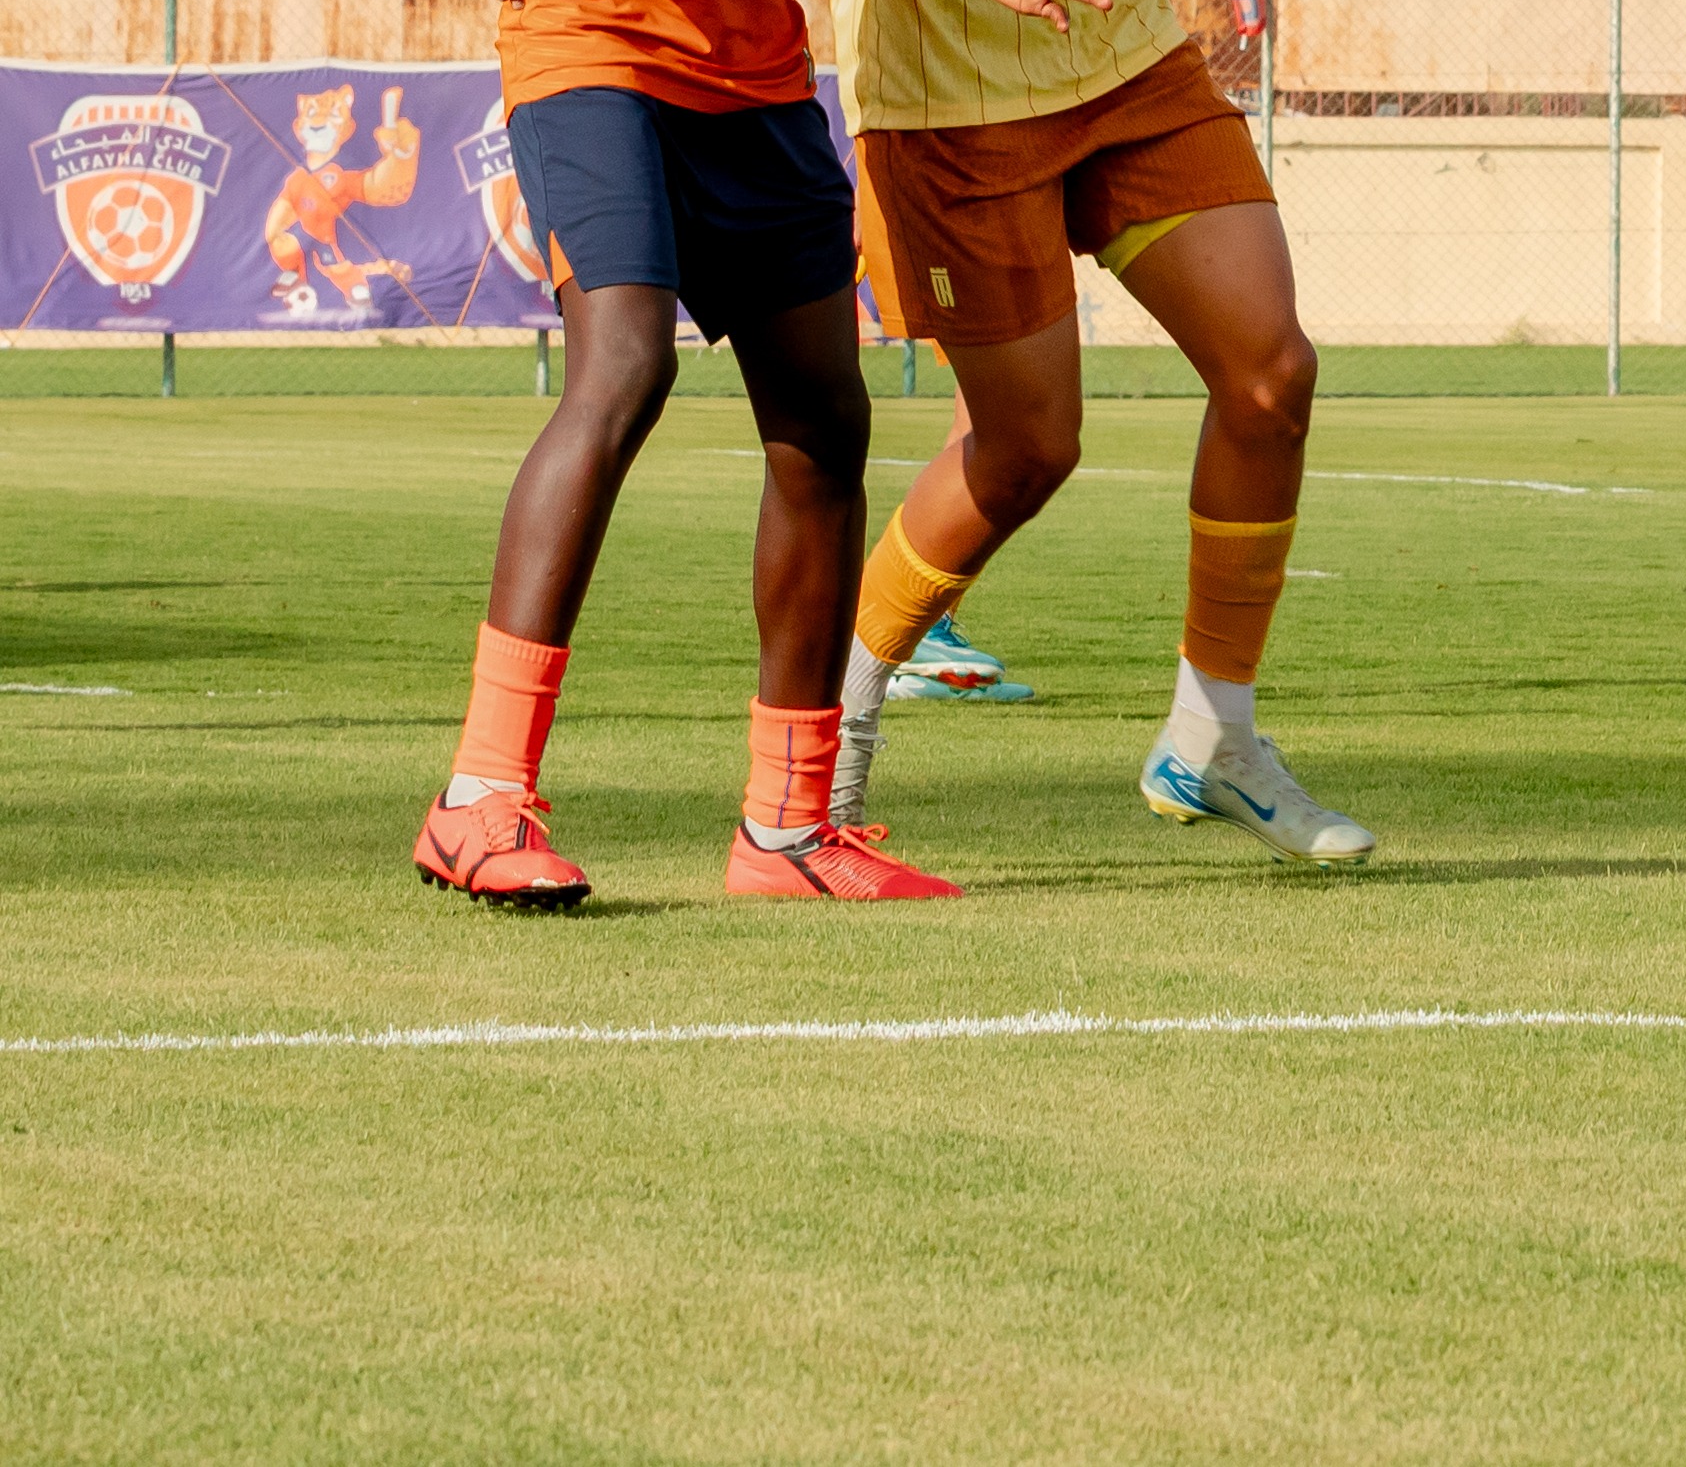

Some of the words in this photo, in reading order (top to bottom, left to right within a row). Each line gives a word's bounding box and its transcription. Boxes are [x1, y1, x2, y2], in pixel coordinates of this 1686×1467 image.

[154, 134, 212, 161] نادي
[56, 152, 145, 180] ALFAYHA
[152, 152, 203, 180] CLUB
